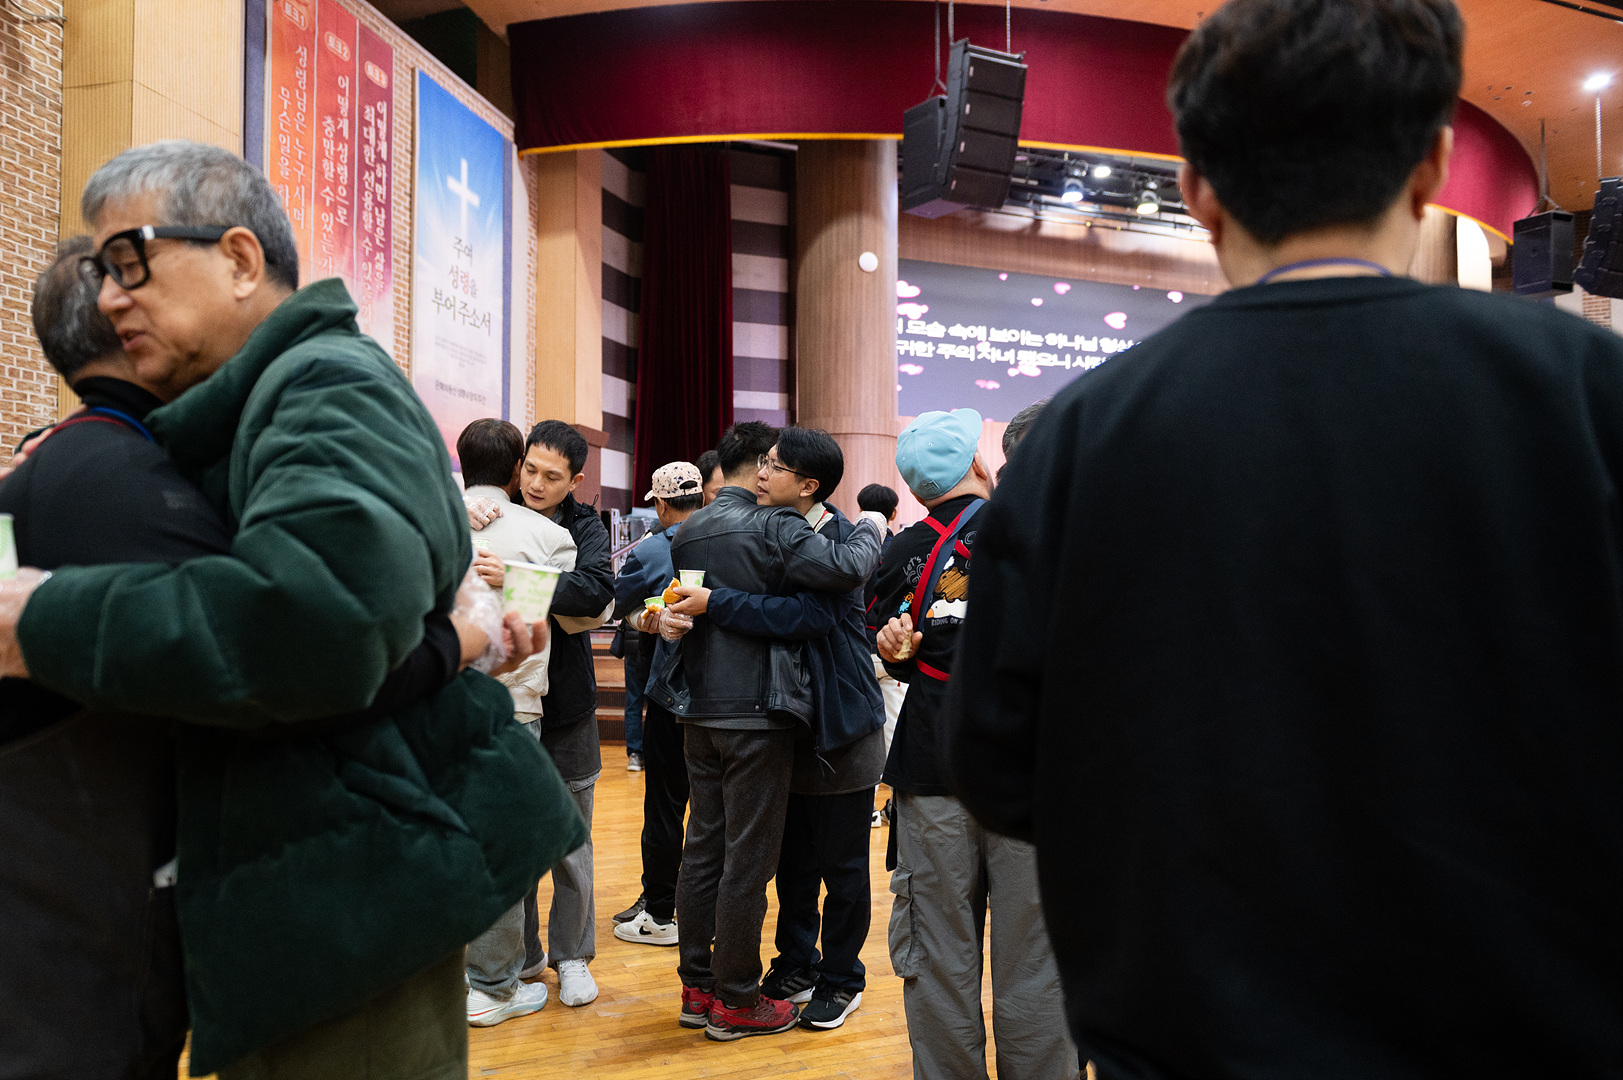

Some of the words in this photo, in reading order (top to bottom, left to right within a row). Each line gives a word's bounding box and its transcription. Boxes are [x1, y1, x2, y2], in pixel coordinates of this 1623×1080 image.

[294, 44, 307, 135] 성령님은
[337, 75, 349, 140] 어떻게
[322, 115, 336, 182] 충만할
[363, 104, 376, 168] 최대한
[376, 100, 388, 162] 어떻게
[293, 137, 307, 230] 누구시며
[320, 185, 335, 207] 수
[336, 142, 350, 227] 성령으로
[375, 163, 388, 204] 하면
[361, 236, 374, 257] 수
[374, 206, 387, 248] 남은
[453, 236, 473, 267] 주여
[448, 264, 478, 299] 성령을
[432, 287, 456, 322] 부어
[457, 301, 491, 337] 주소서
[936, 343, 976, 361] 주의
[947, 323, 987, 342] 속에
[988, 327, 1044, 347] 보이는
[1044, 332, 1098, 352] 하나님
[931, 617, 948, 627] RIDING
[949, 617, 959, 625] ON
